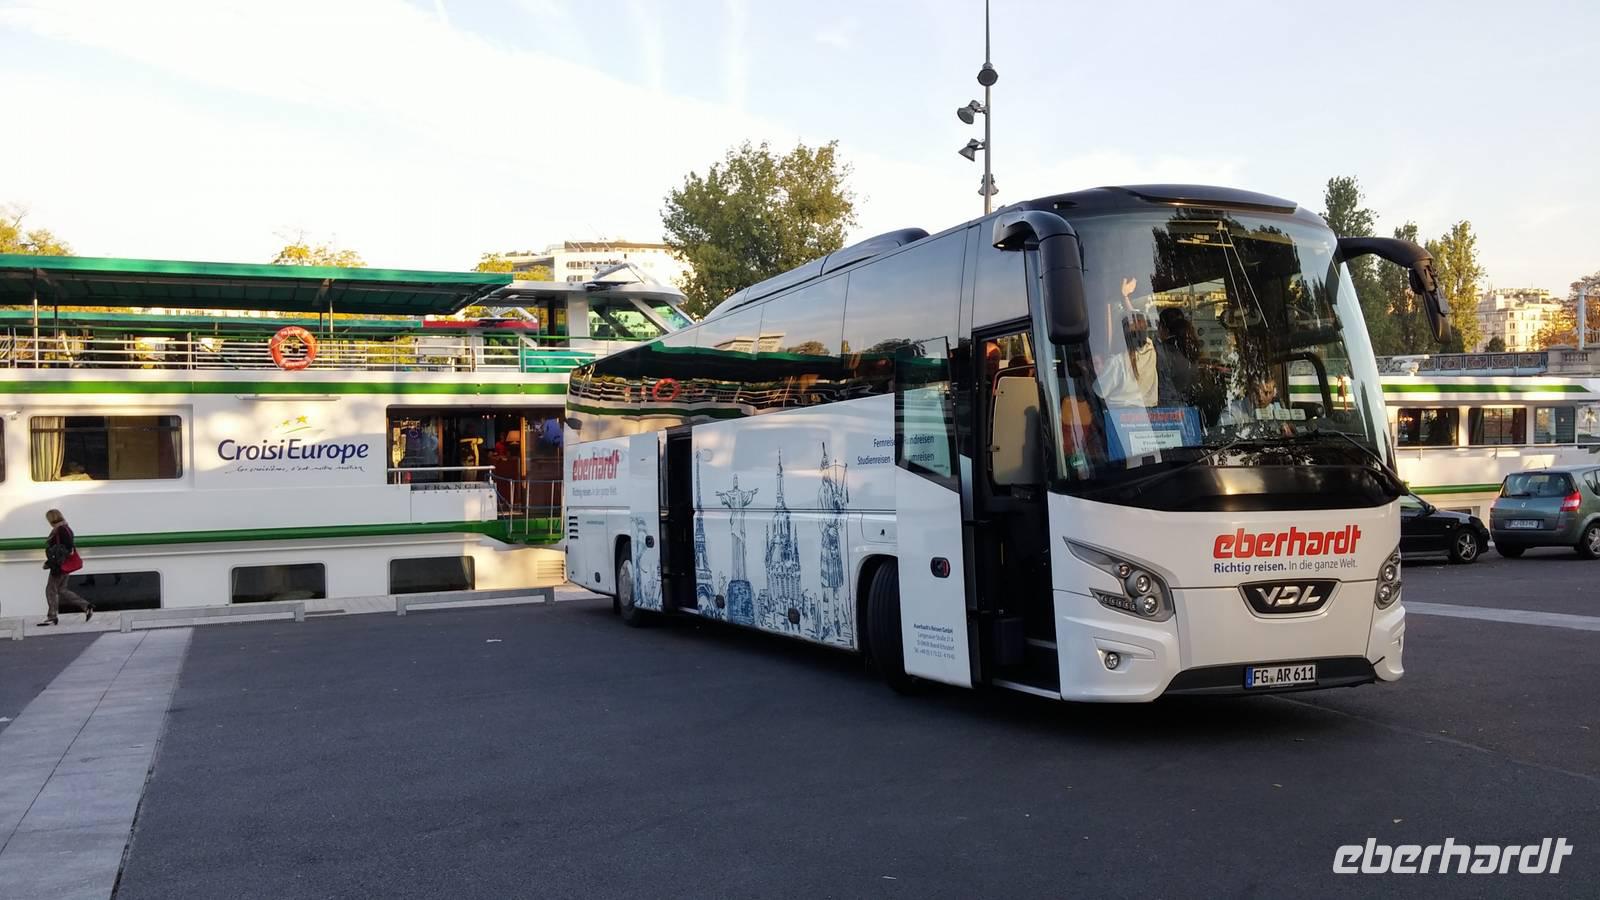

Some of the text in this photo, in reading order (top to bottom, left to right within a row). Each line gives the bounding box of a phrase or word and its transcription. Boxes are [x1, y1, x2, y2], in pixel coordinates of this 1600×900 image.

[218, 439, 369, 464] CroisiEurope
[1213, 524, 1362, 559] eberhardt
[1214, 558, 1358, 575] Richtig reisen. In die ganze Welt.
[1255, 585, 1321, 607] VDL
[1253, 666, 1315, 684] FG AR 611
